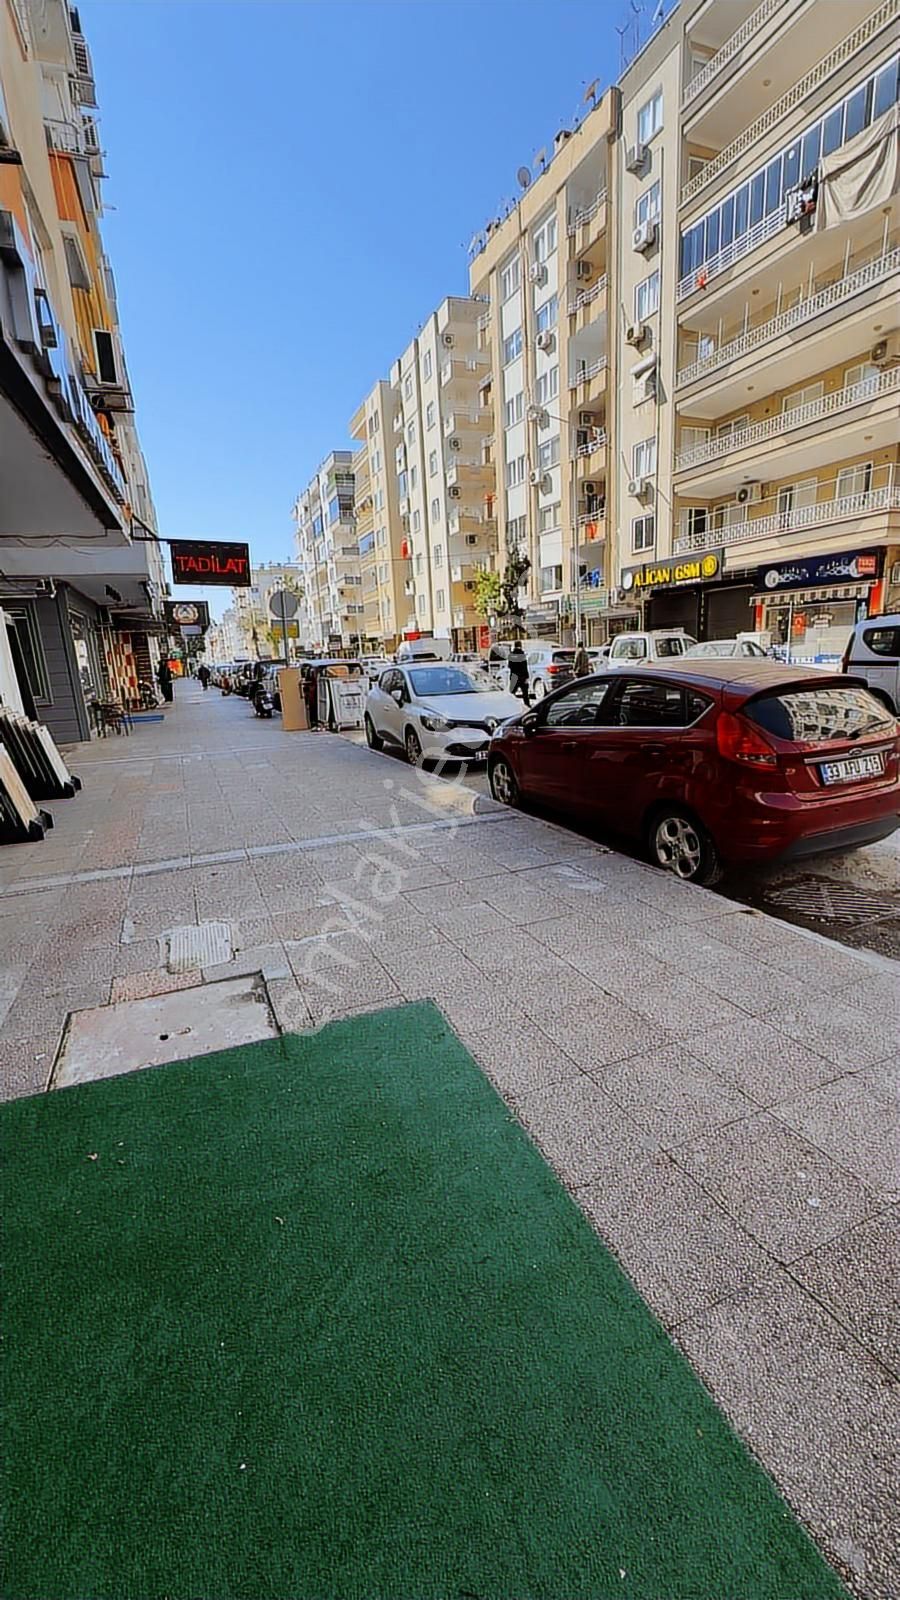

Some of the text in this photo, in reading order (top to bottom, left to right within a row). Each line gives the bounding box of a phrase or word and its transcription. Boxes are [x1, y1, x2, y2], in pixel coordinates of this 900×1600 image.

[176, 554, 247, 574] TADİLAT
[675, 561, 701, 581] GSM
[828, 764, 841, 778] 33
